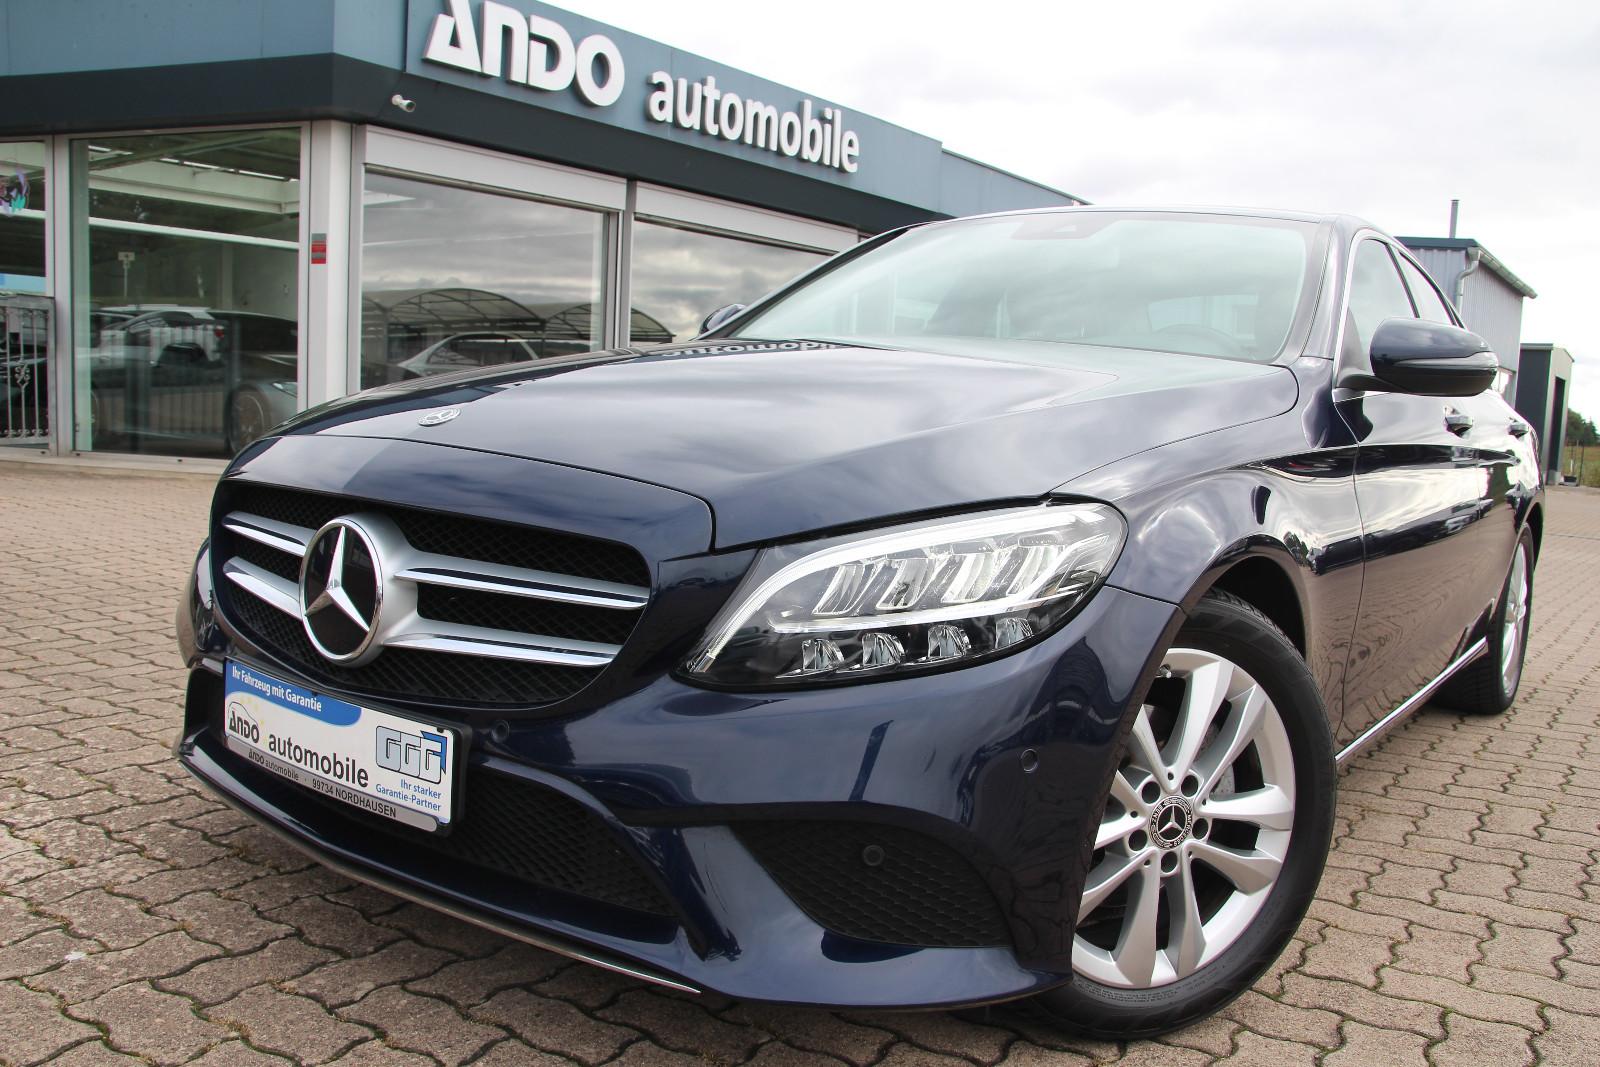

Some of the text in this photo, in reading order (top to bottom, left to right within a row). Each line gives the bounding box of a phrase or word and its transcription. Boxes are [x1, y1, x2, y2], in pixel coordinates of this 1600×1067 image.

[422, 0, 859, 174] ANDO automobile
[232, 666, 322, 712] Ihr Fahrzeug mit Garantie
[229, 710, 369, 788] ANDO automobile
[265, 759, 299, 781] automobile
[312, 778, 334, 794] 99734
[335, 786, 397, 818] NORDHAUSEN
[375, 783, 442, 812] Garantie-Partner
[400, 779, 442, 800] Ihr starker
